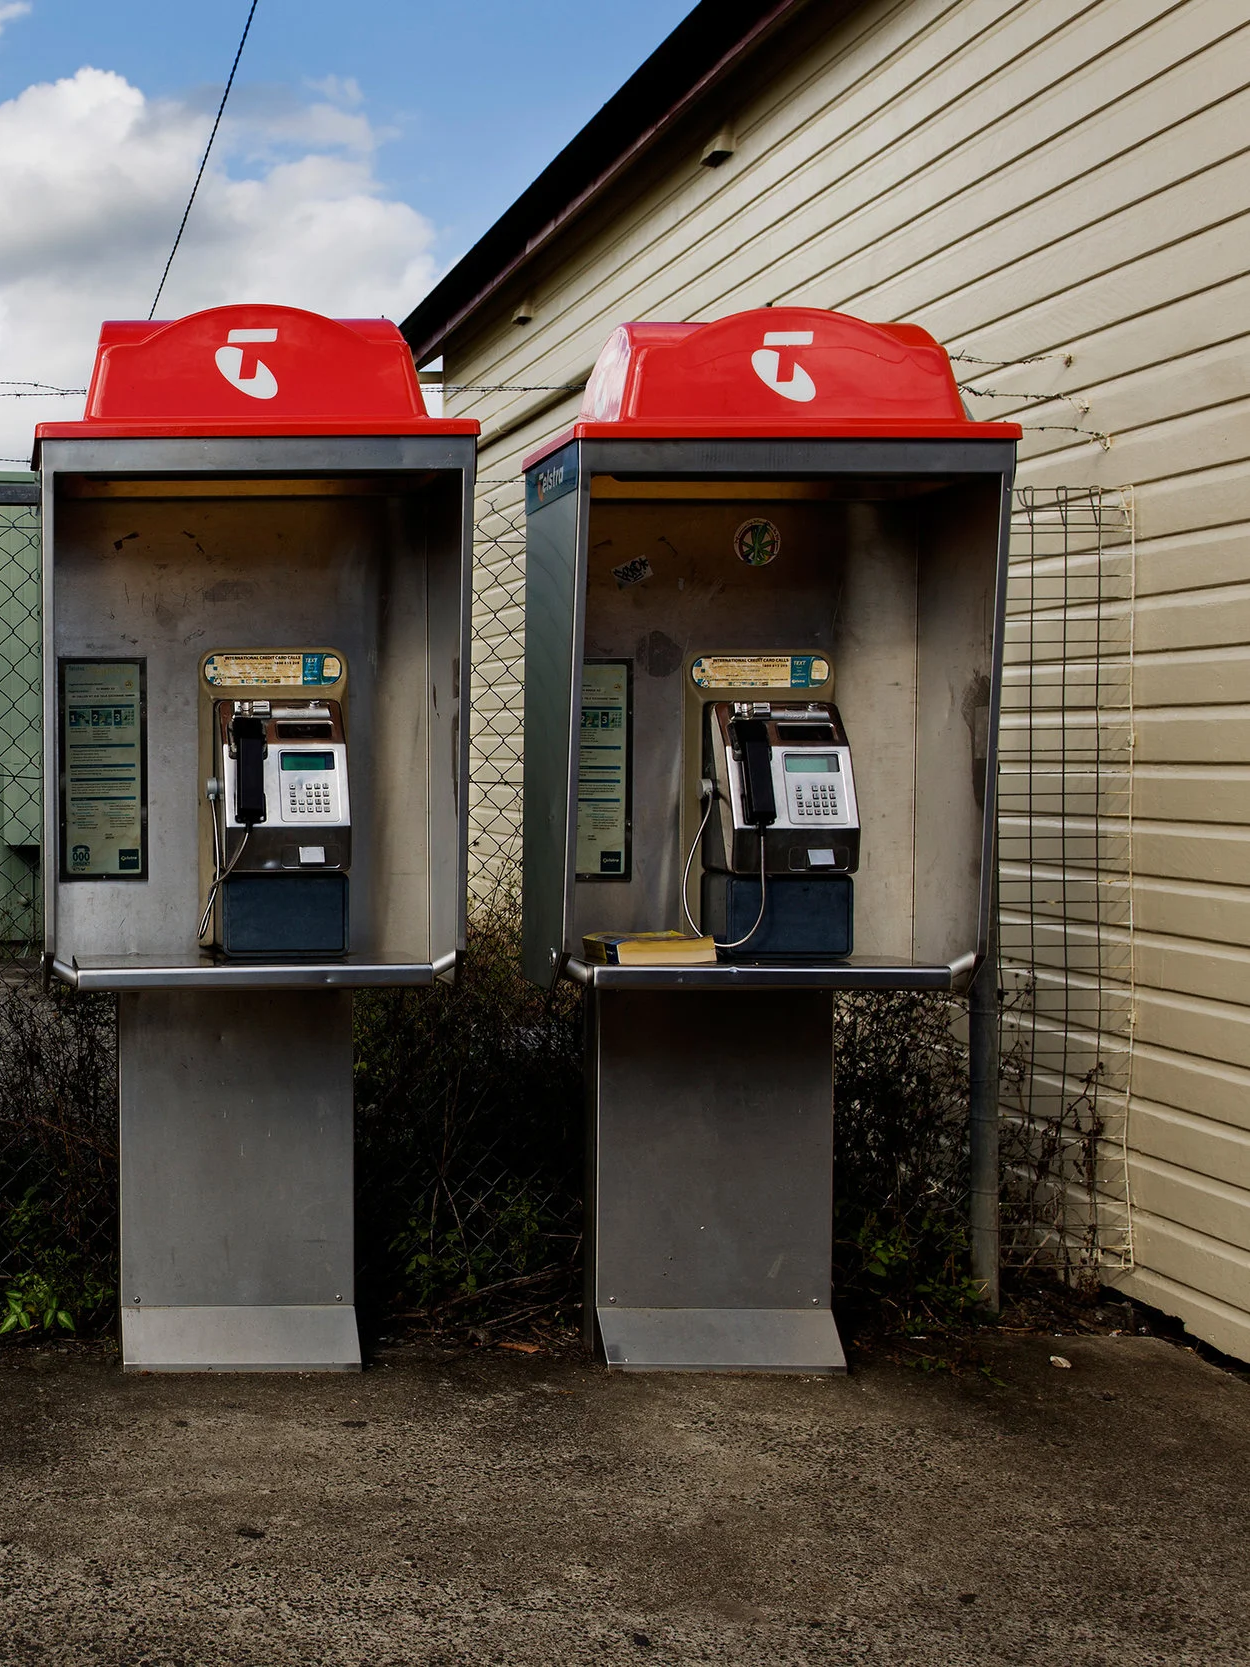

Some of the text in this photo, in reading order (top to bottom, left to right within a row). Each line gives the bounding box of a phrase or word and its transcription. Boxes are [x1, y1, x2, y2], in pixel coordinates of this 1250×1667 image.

[538, 466, 564, 502] Telstra
[70, 714, 76, 722] 1
[92, 714, 98, 722] 2
[115, 714, 120, 722] 3
[602, 716, 608, 724] 3
[72, 852, 90, 861] 000
